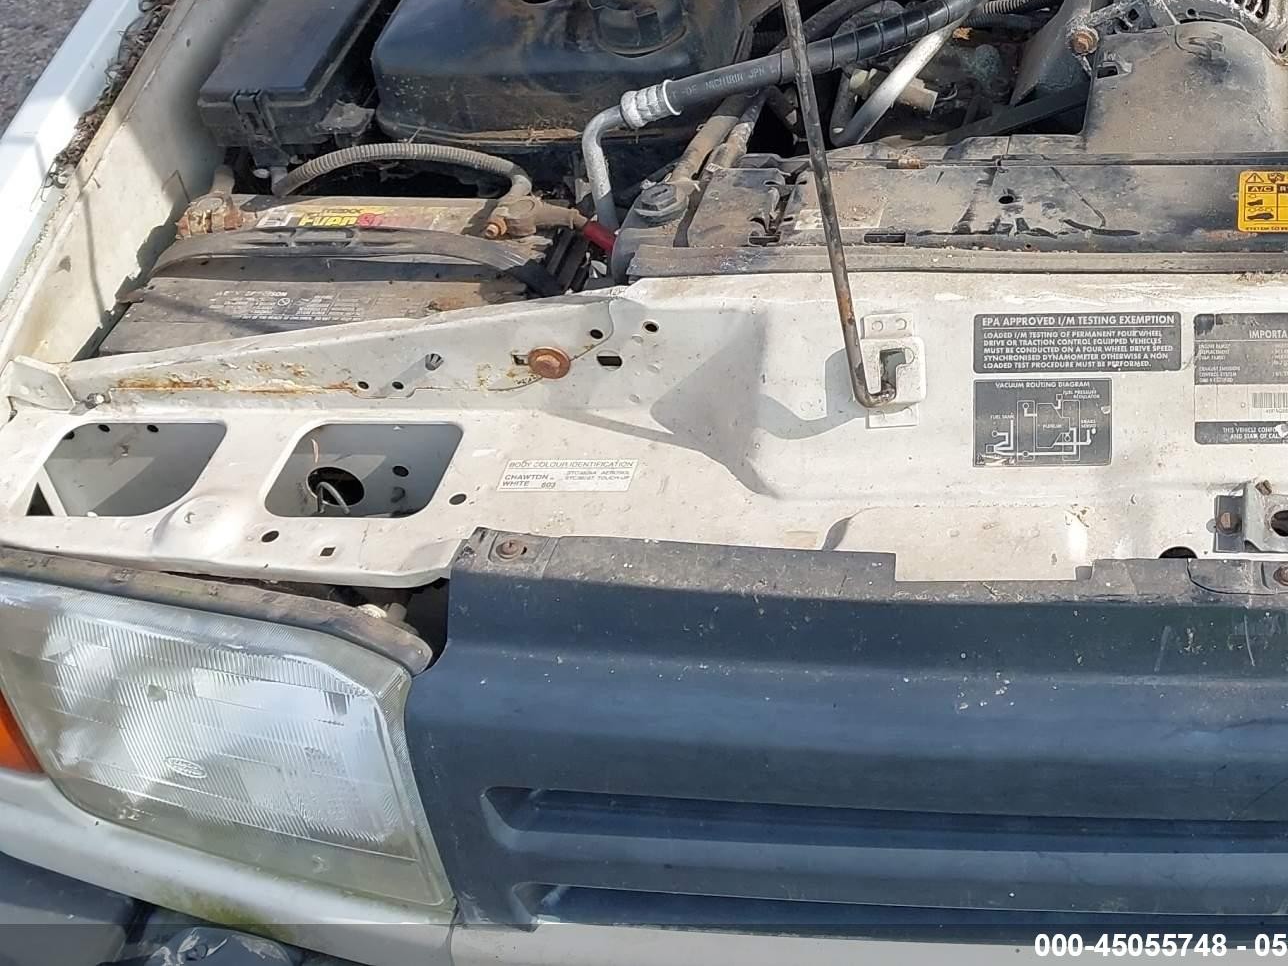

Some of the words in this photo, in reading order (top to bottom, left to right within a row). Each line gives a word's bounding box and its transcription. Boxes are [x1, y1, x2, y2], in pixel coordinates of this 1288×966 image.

[982, 317, 1000, 326] EPA
[1003, 316, 1055, 326] APPROVED
[1058, 316, 1075, 326] I/M
[1078, 316, 1116, 325] TESTING
[1119, 315, 1175, 324] EXEMPTION
[569, 460, 634, 468] IDENTIFICATION
